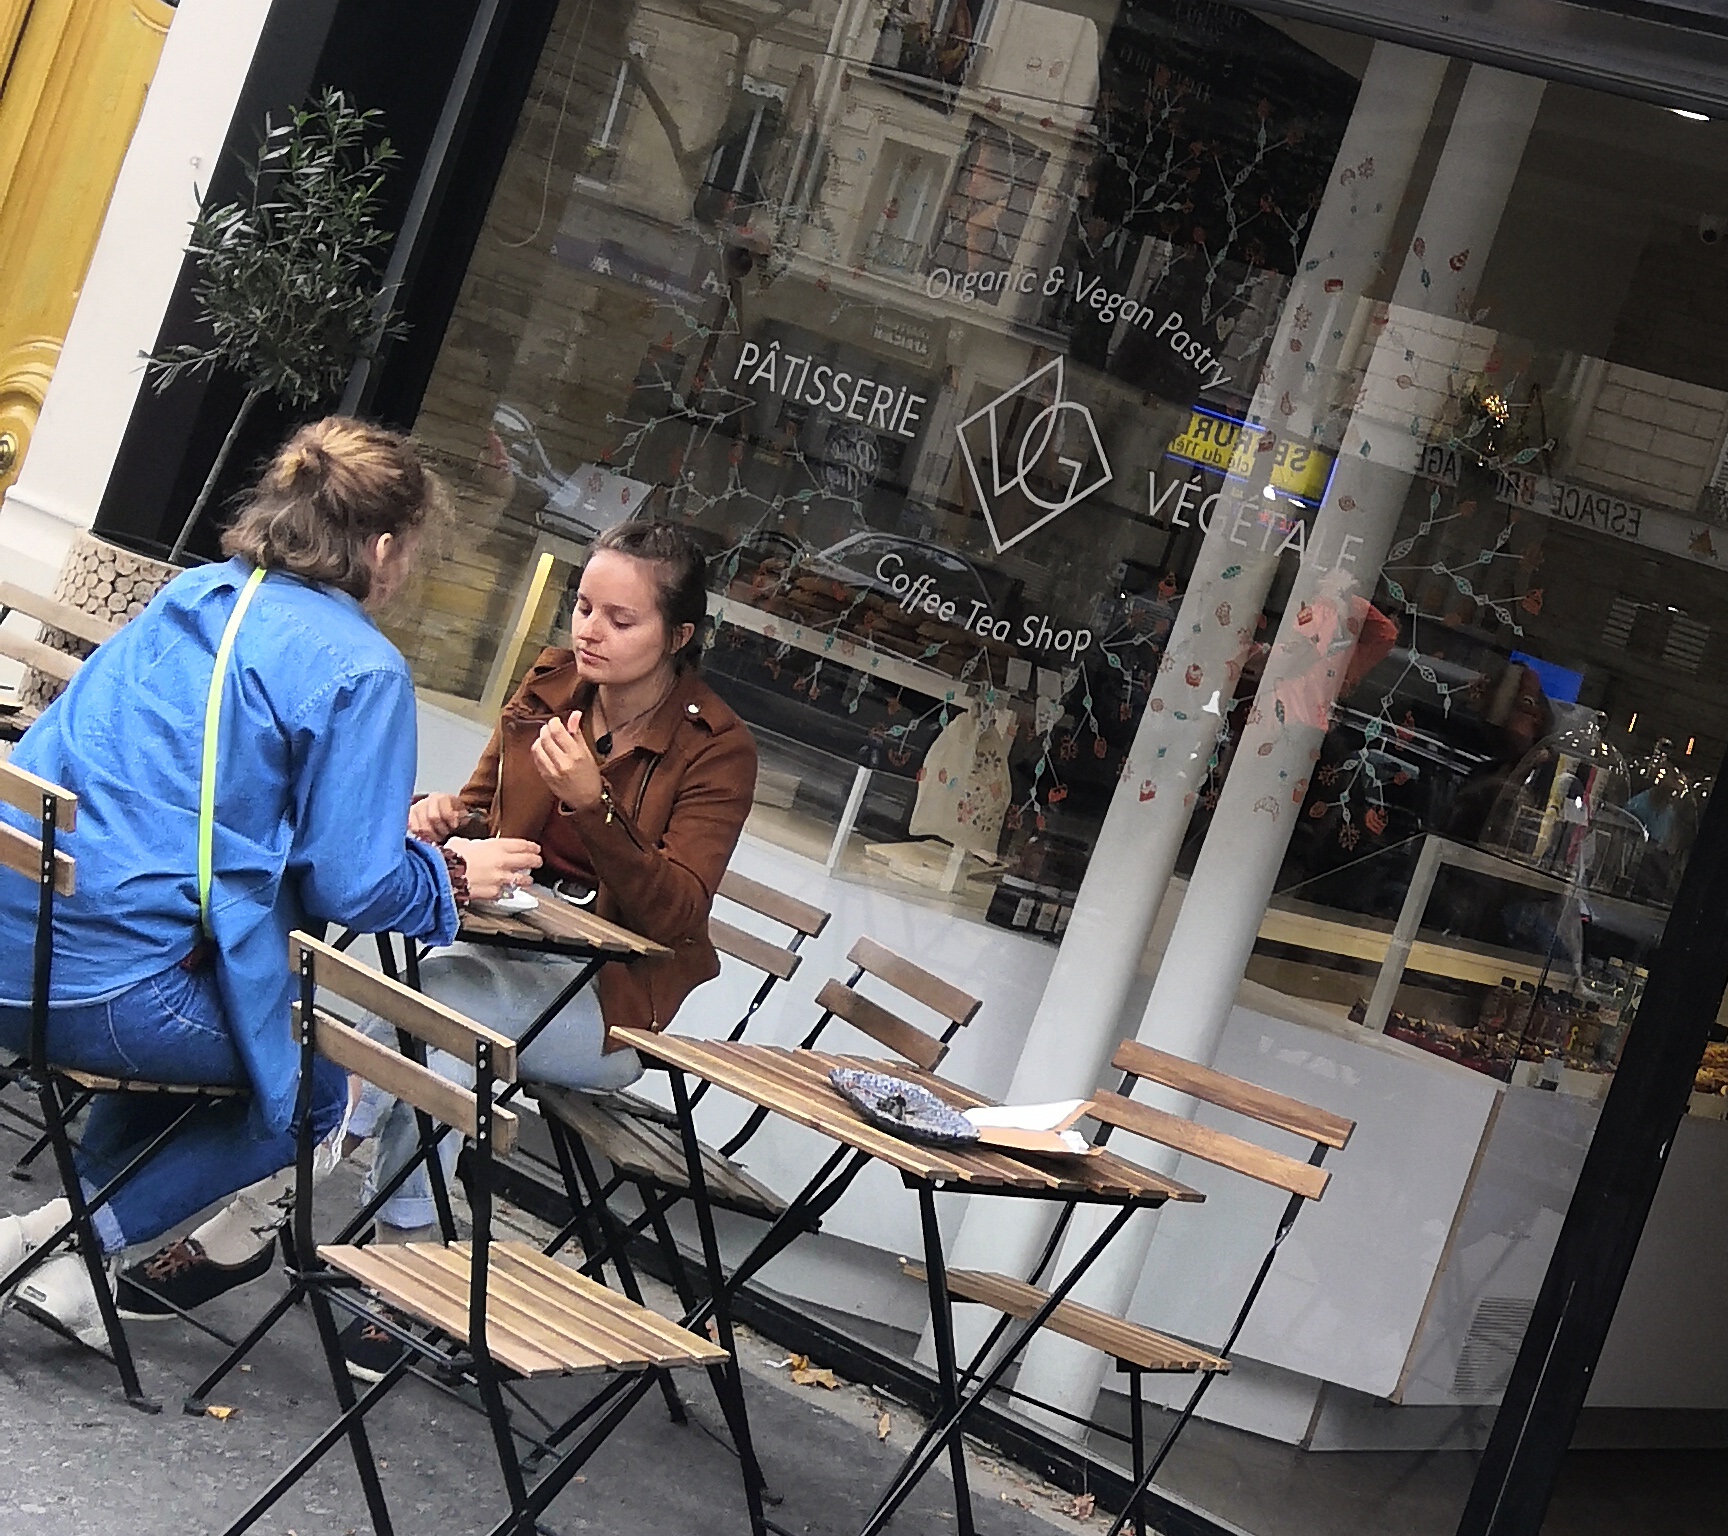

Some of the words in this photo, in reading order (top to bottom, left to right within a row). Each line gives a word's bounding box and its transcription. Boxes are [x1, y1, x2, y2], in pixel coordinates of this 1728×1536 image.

[926, 265, 1037, 303] Organic
[1042, 266, 1065, 295] &
[1074, 270, 1155, 331] Vegan
[1155, 308, 1233, 391] Pastry
[733, 338, 927, 439] PÂTISSERIE
[1147, 470, 1364, 572] VÉGÉTALE
[875, 553, 957, 626] Coffee
[962, 599, 1012, 642] Tea
[1016, 614, 1092, 660] Shop
